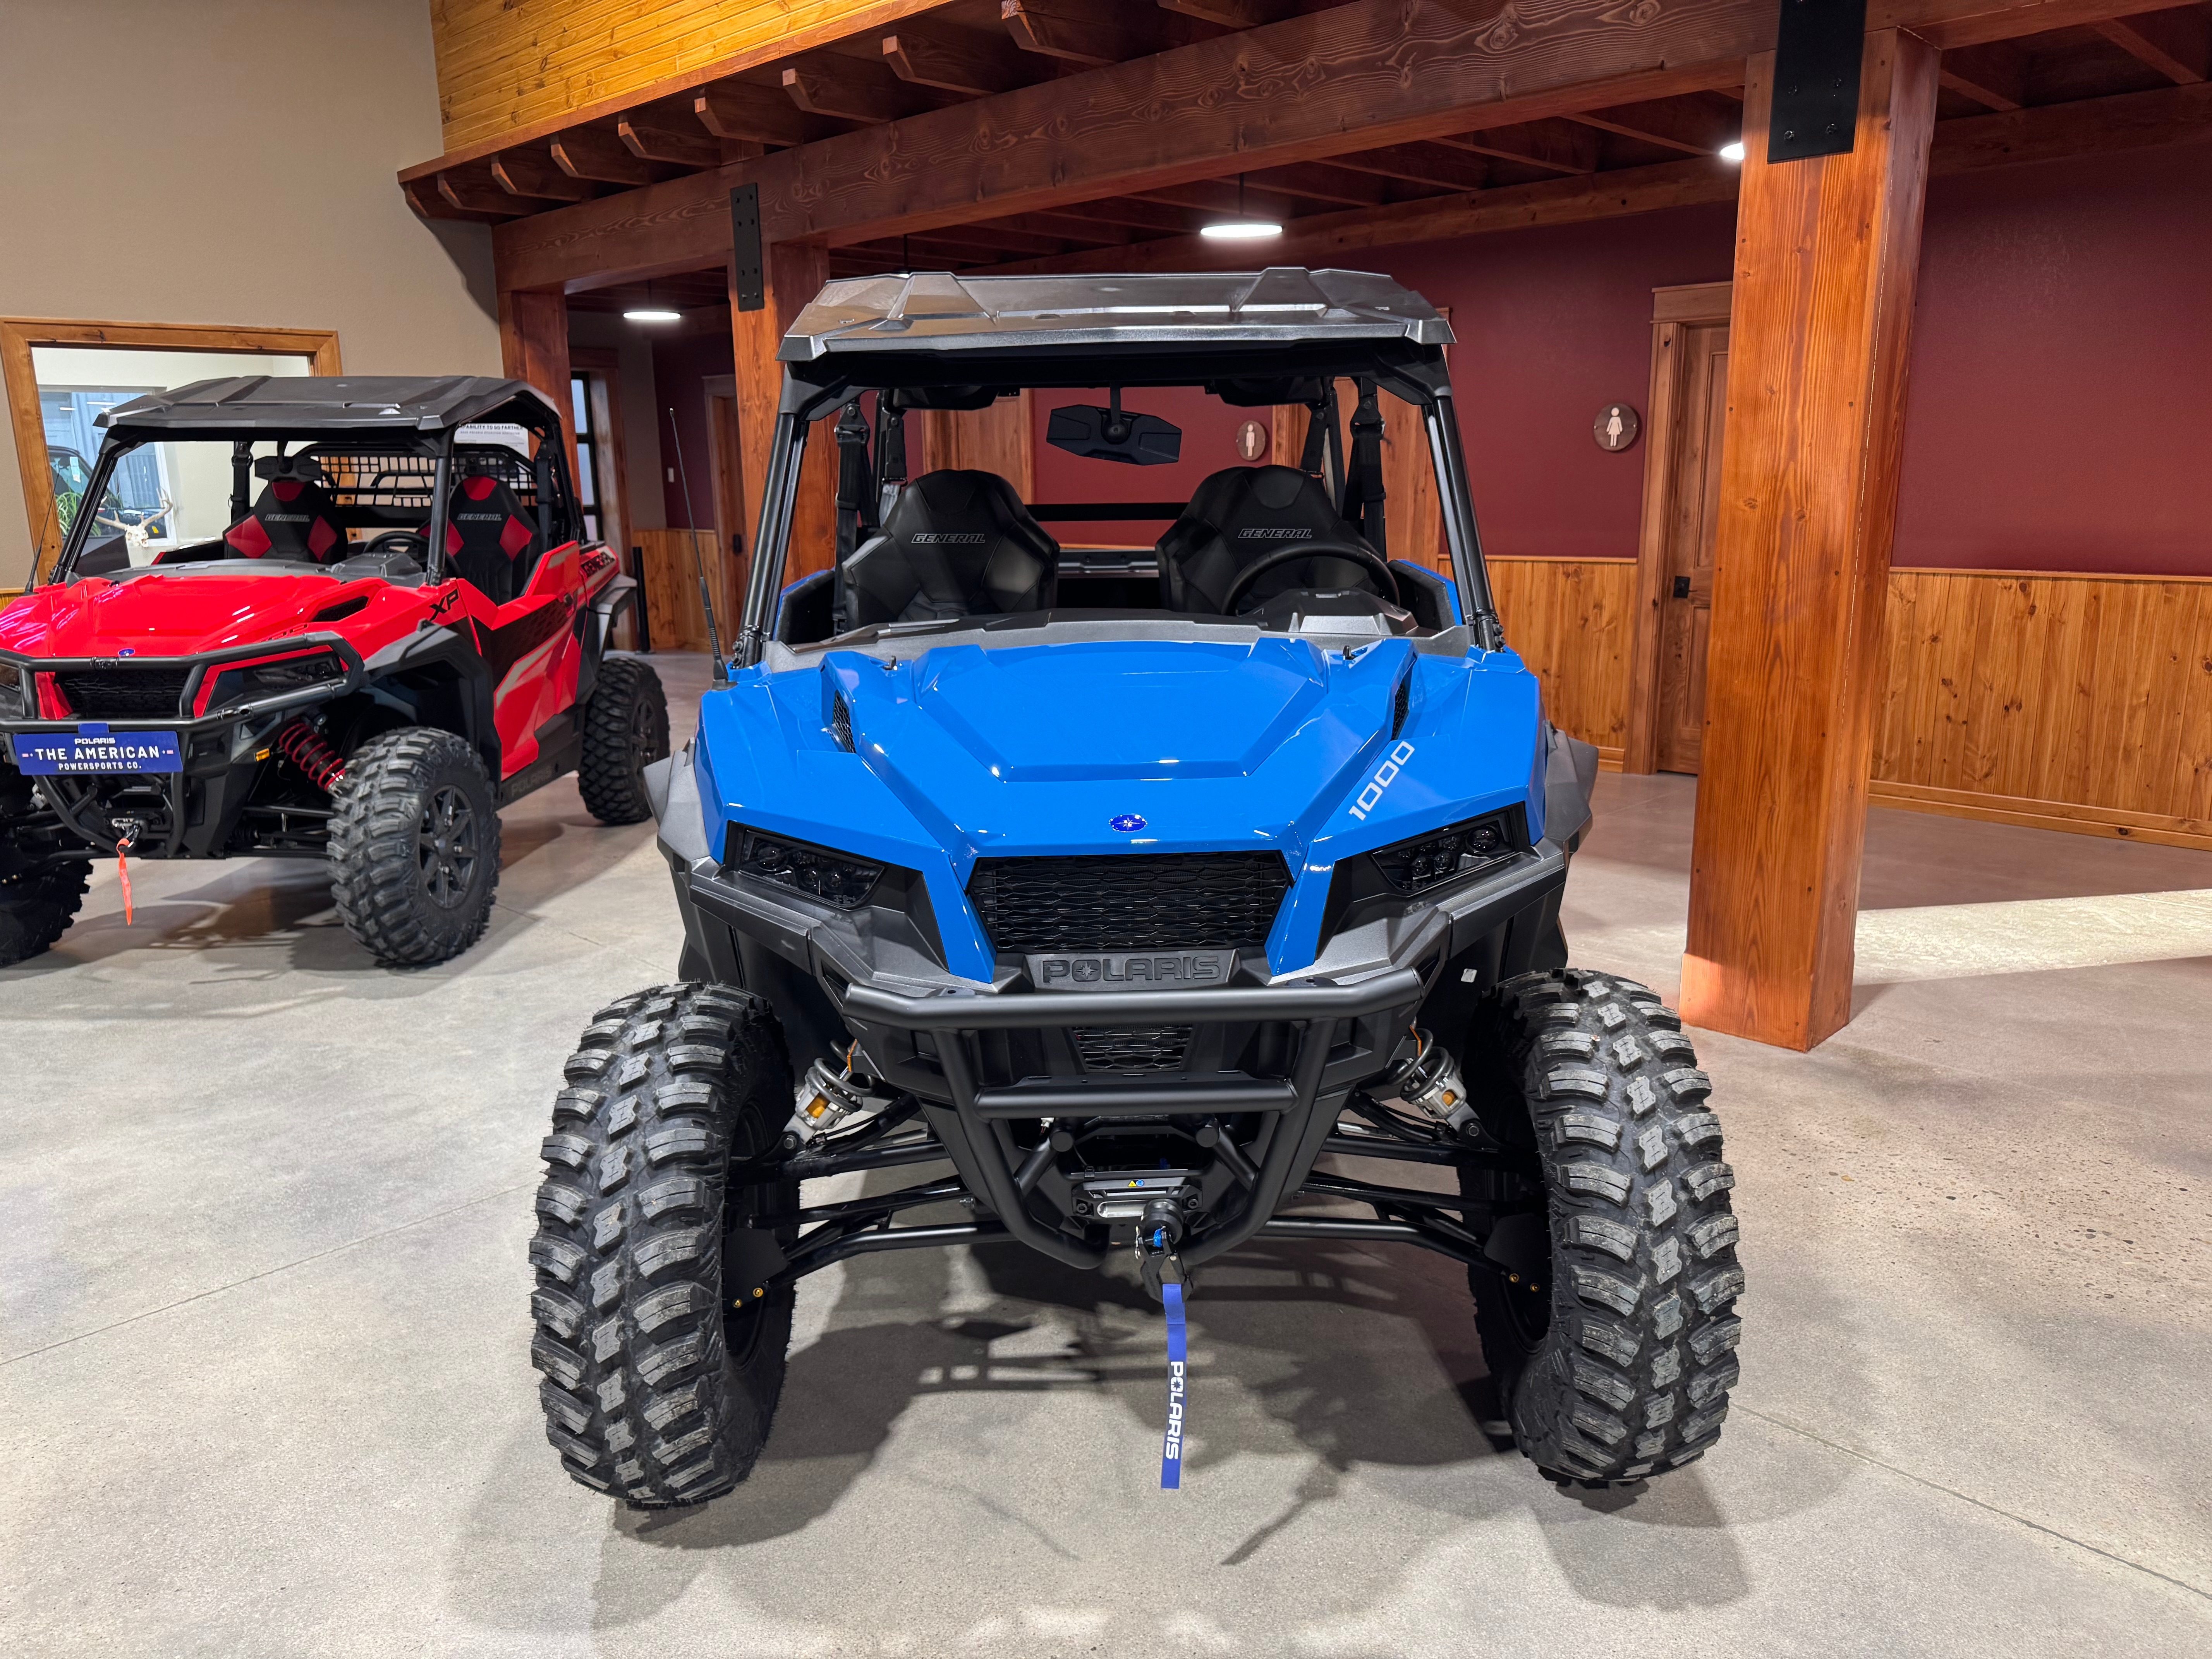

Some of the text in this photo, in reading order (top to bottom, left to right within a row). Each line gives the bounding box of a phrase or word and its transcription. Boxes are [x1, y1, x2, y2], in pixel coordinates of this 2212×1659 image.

[911, 533, 986, 544] GENERAL
[1238, 528, 1312, 539] GENERAL
[429, 588, 459, 621] XP
[35, 746, 160, 760] THE AMERICAN
[58, 761, 123, 771] POWERSPORTS
[1348, 740, 1415, 821] 1000
[1042, 957, 1219, 983] POLARIS
[1166, 1361, 1183, 1460] POLARIS
